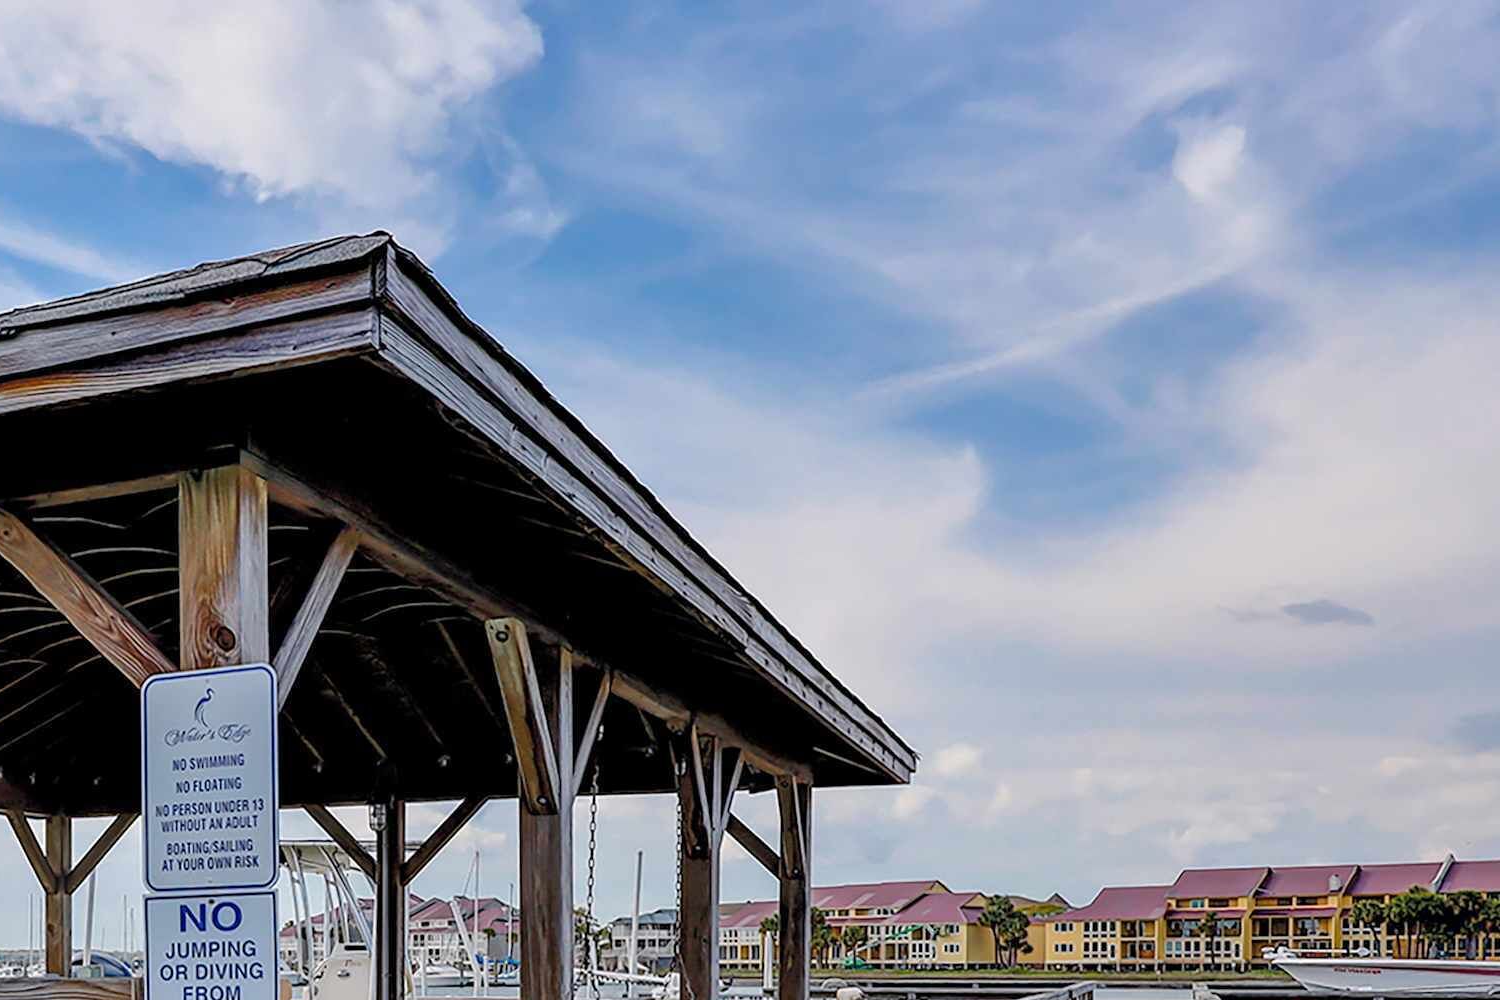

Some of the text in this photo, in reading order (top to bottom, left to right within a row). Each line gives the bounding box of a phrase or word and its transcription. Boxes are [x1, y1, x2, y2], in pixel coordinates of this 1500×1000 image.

[164, 724, 252, 747] Water's Edge
[172, 753, 245, 771] NO SWIMMING
[176, 777, 242, 793] NO FLOATING
[155, 798, 264, 817] NO PERSON UNDER 13
[161, 815, 258, 832] WITHOUT AN ADULT
[166, 839, 253, 856] BOATING/SAILING
[162, 855, 259, 871] AT YOUR OWN RISK
[179, 901, 242, 932] NO
[165, 940, 256, 959] JUMPING
[160, 962, 263, 981] OR DIVING
